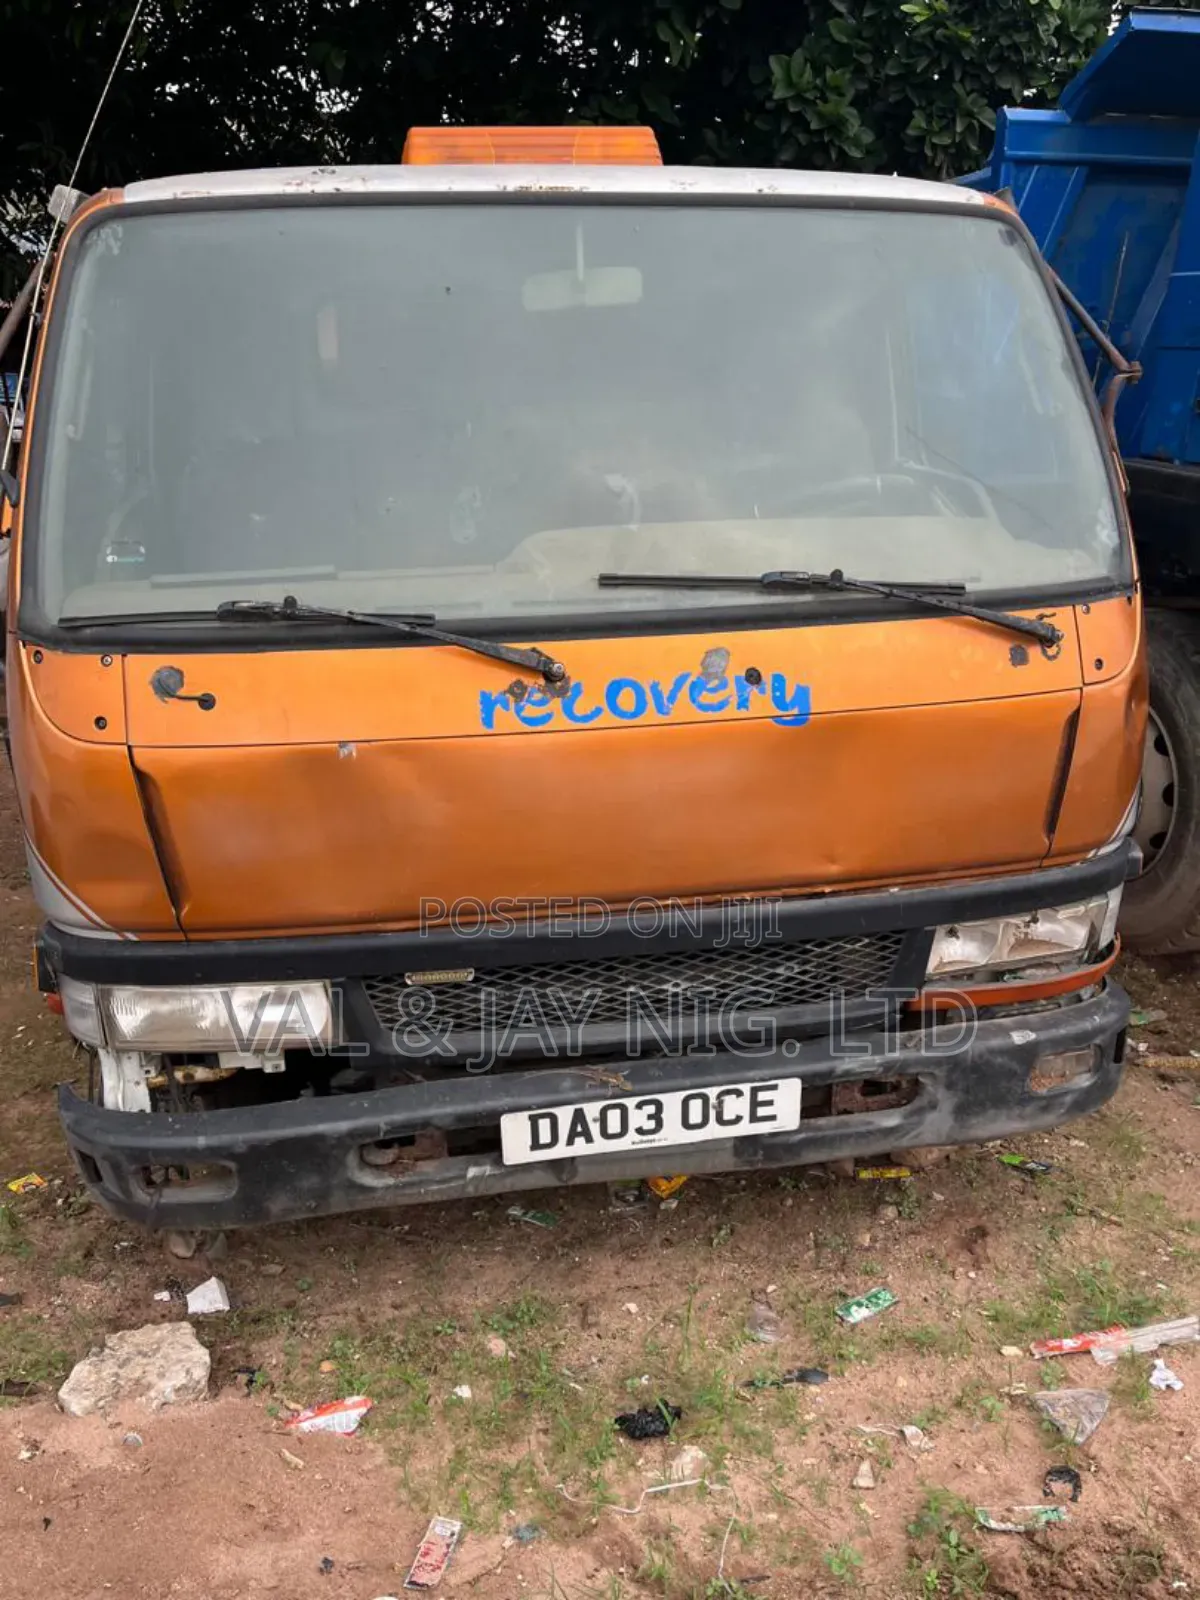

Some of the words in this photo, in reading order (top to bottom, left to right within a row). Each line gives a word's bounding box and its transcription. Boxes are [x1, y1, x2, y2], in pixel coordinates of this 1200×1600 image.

[479, 671, 812, 728] recovery
[527, 1097, 664, 1152] DA03
[680, 1083, 779, 1131] OCE
